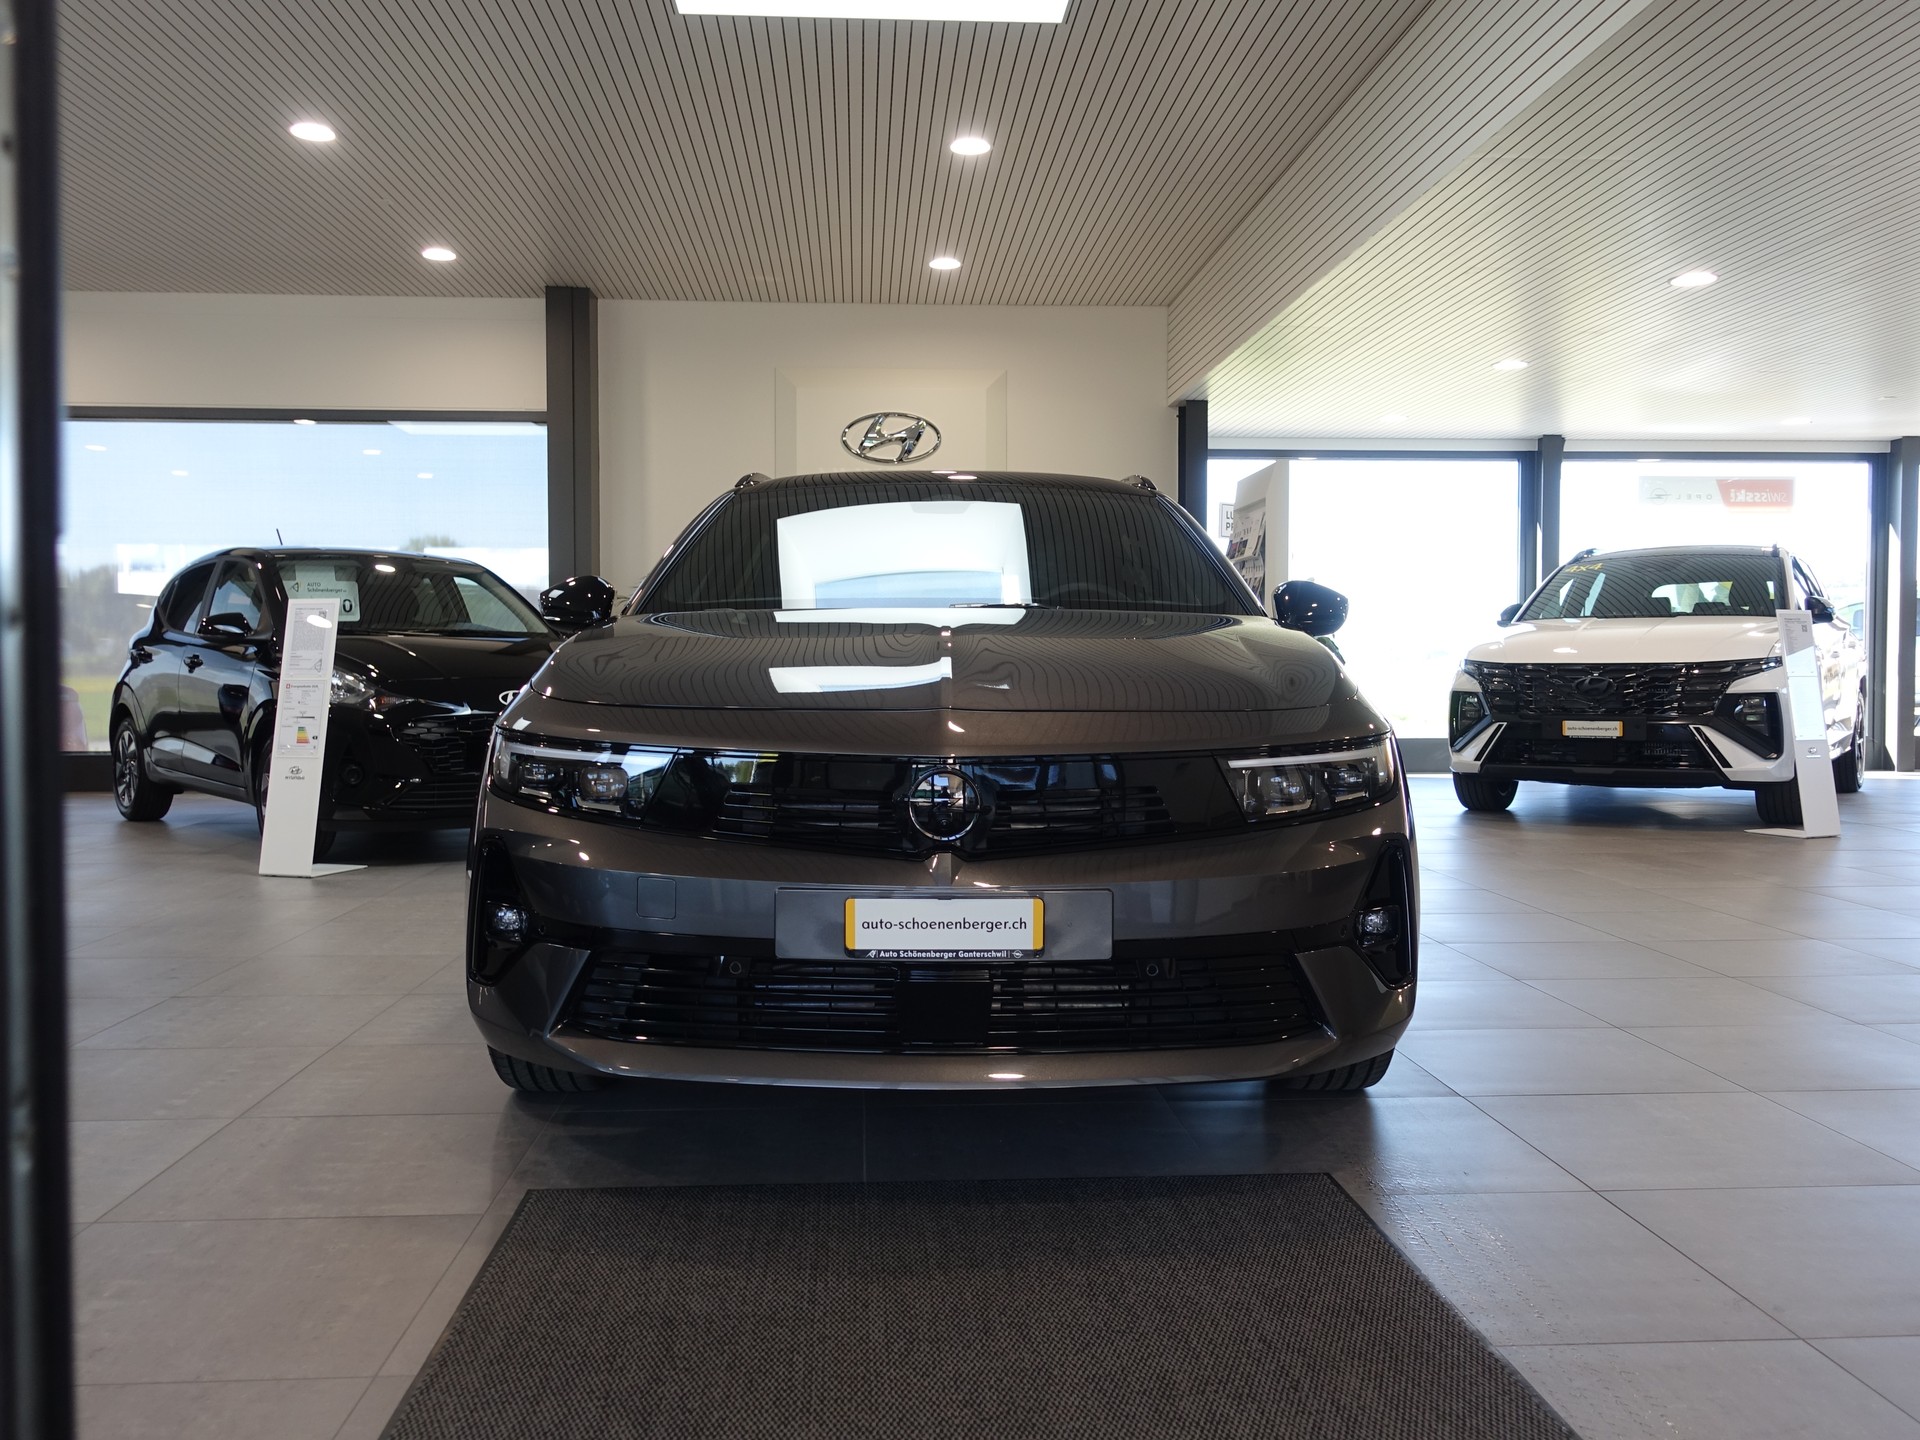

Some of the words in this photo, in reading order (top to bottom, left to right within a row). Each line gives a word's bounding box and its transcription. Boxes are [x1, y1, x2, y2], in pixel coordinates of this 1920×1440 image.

[861, 917, 1027, 933] auto-schoenenberger.ch
[879, 950, 897, 958] Auto
[899, 950, 956, 959] Schönenberger
[958, 950, 1007, 959] Ganterschwil
